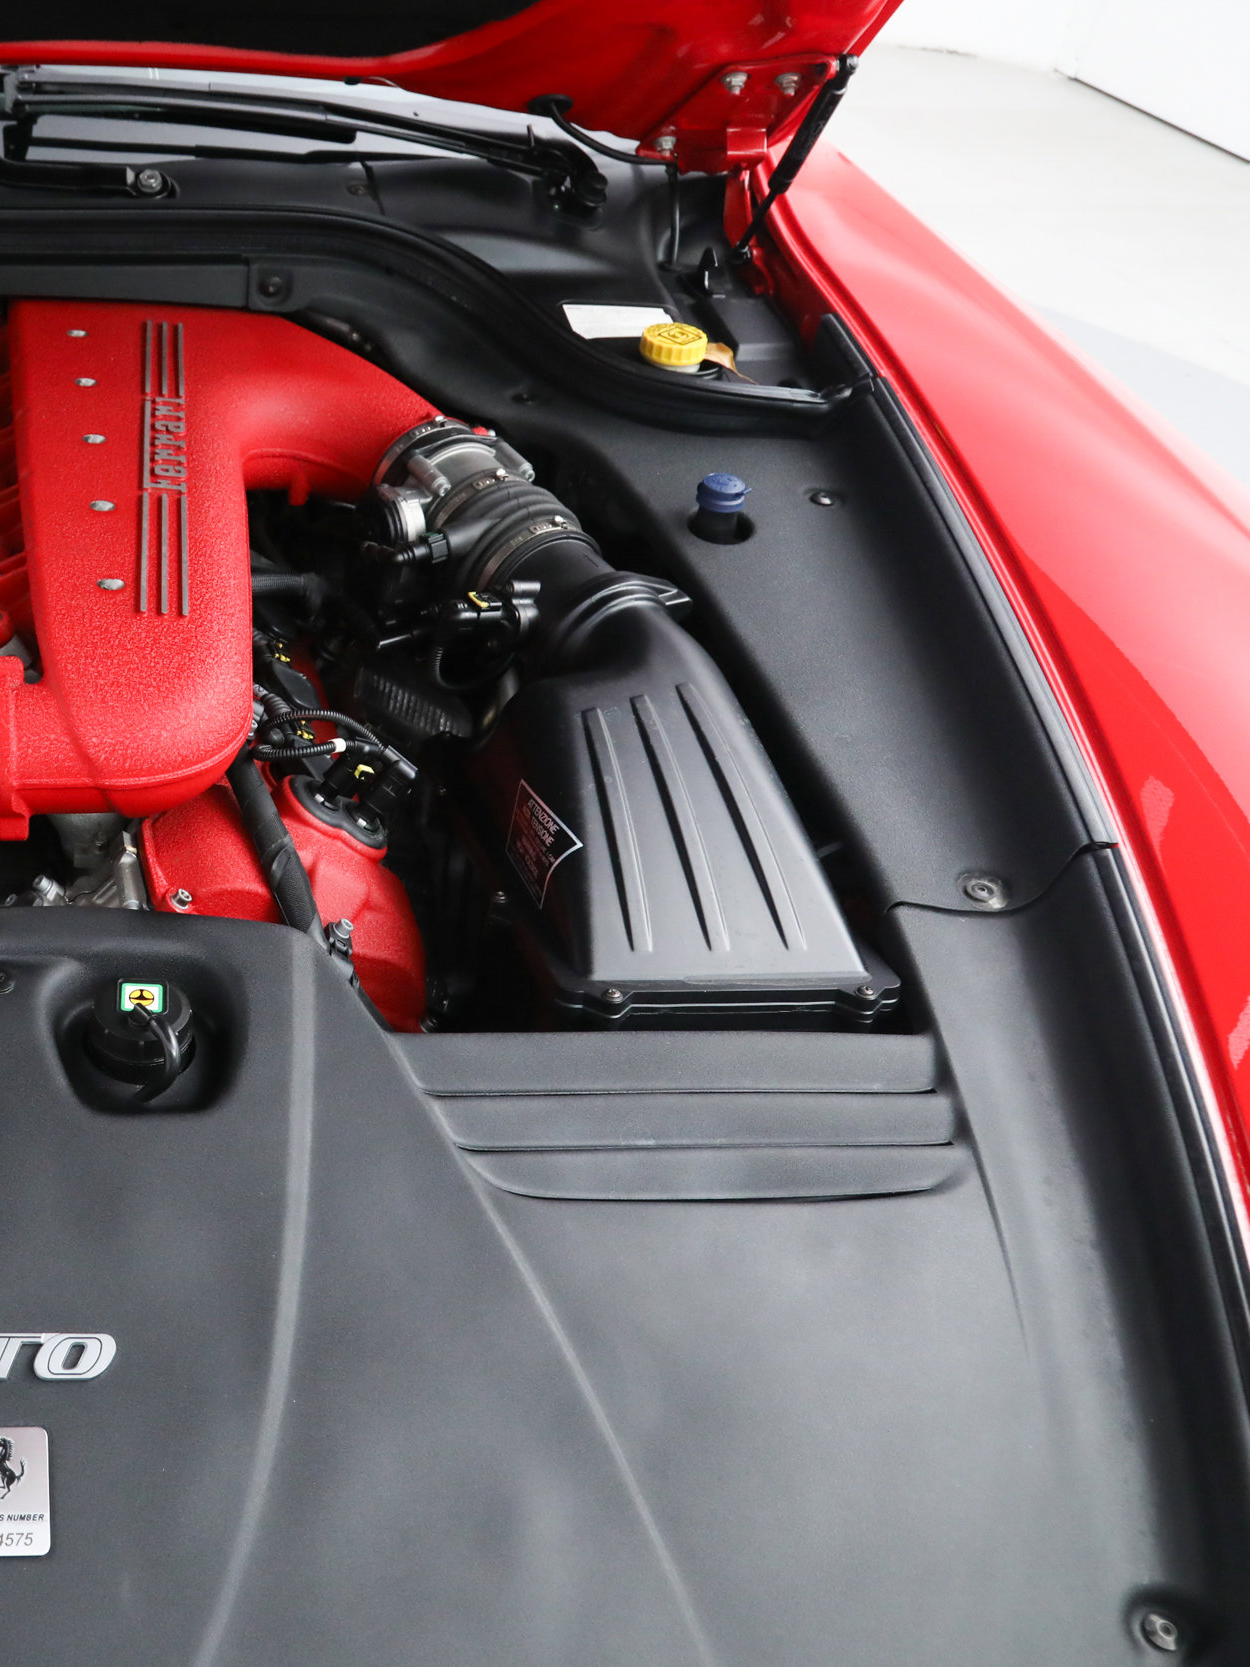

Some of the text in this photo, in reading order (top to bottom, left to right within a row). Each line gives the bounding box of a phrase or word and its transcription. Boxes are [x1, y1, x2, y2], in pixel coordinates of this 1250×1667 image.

[143, 397, 186, 492] Ferrari
[528, 798, 560, 835] ATTENZIONE
[6, 1513, 45, 1522] NUMBER
